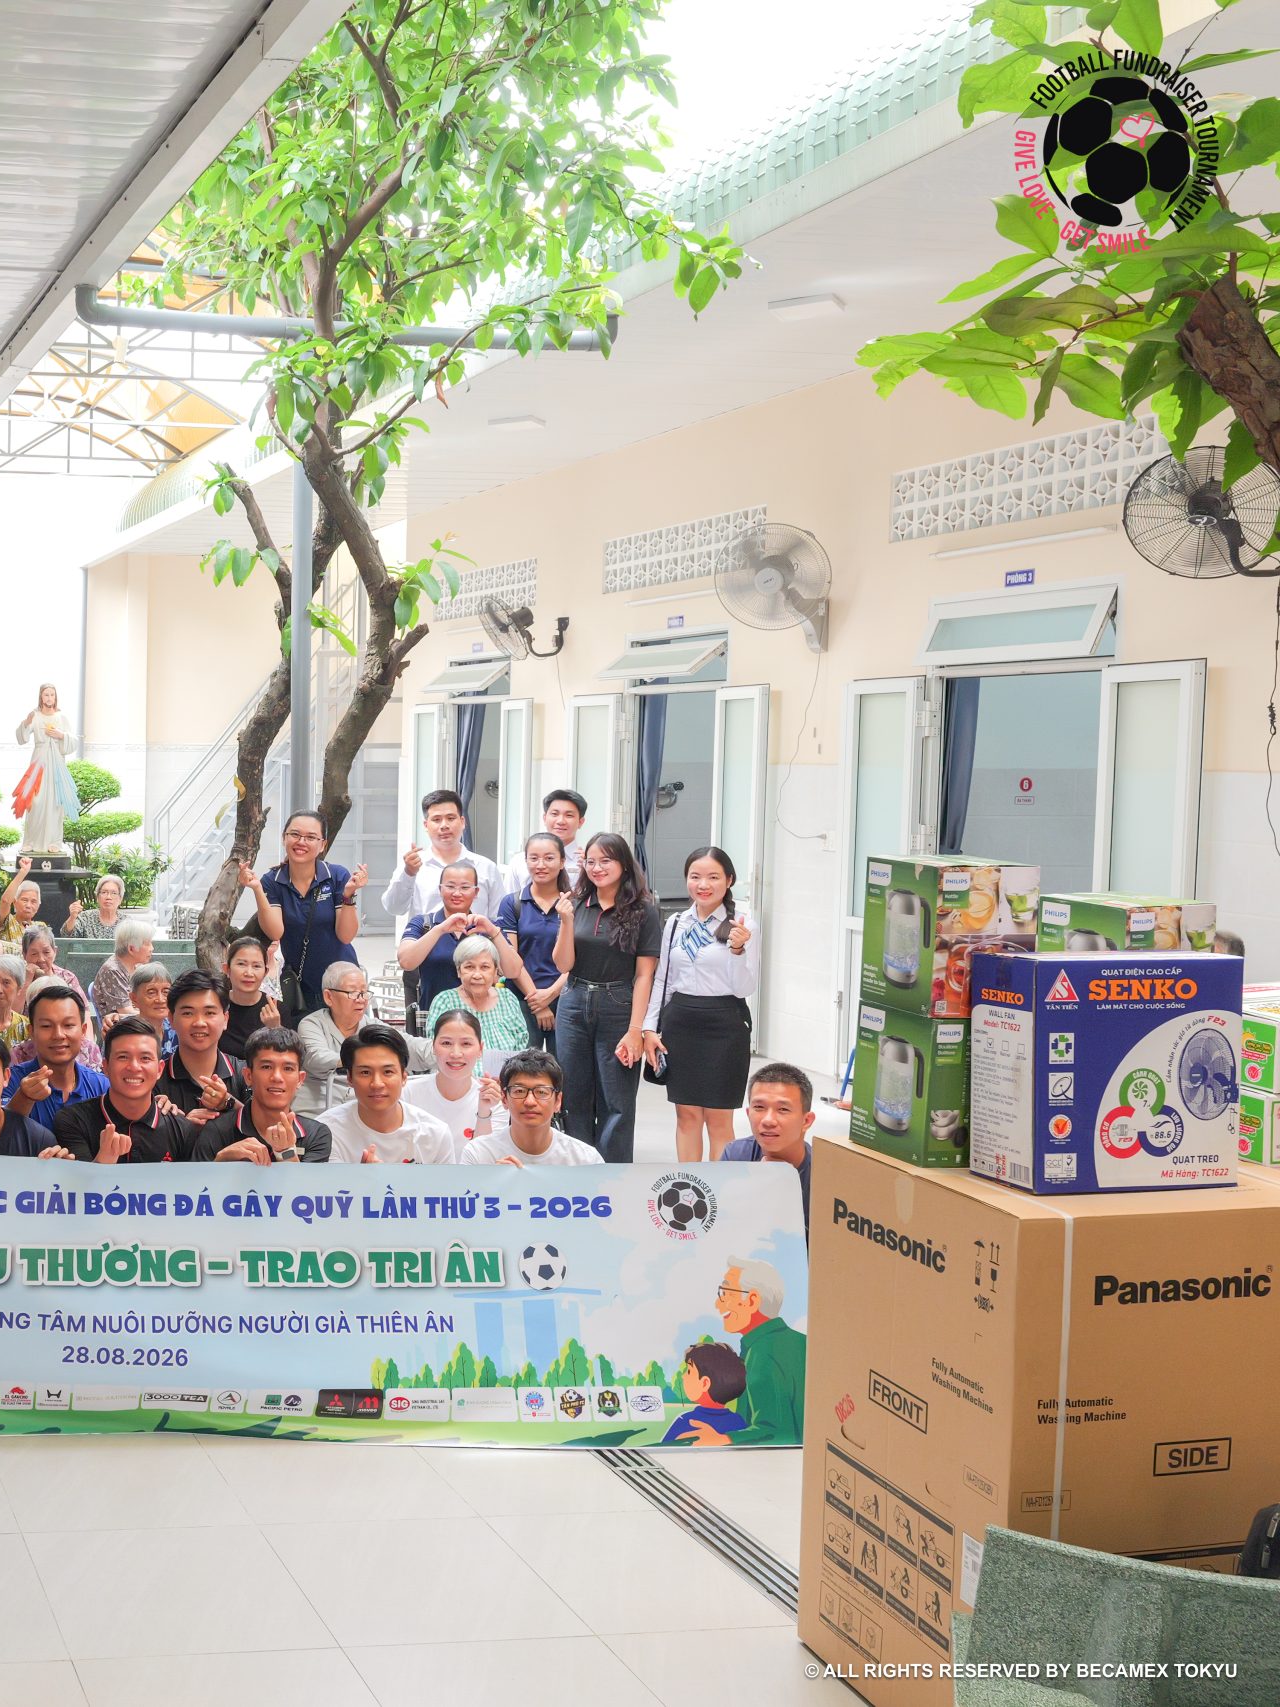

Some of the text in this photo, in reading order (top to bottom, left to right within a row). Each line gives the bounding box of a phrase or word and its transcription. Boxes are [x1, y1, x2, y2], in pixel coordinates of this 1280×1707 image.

[1028, 572, 1033, 582] 3
[871, 870, 890, 879] PHILIPS
[1044, 909, 1068, 919] PHILIPS
[1124, 968, 1144, 977] ĐIỆN
[1165, 966, 1182, 974] CẤP
[981, 988, 1024, 1005] SENKO
[1088, 978, 1198, 1001] SENKO
[1113, 1002, 1127, 1010] MÁT
[1145, 1002, 1165, 1010] CUỘC
[1166, 1001, 1185, 1009] SỐNG
[862, 1013, 883, 1025] PHILIPS
[988, 1009, 1016, 1020] WALL FAN
[1000, 1021, 1021, 1032] TC1622
[1132, 1070, 1148, 1079] CÁNH
[1172, 1155, 1219, 1165] QUẠT TREO
[1201, 1168, 1229, 1177] TC1622
[15, 1183, 77, 1215] GIẢI
[84, 1185, 167, 1217] BÓNG
[173, 1186, 214, 1217] ĐÁ
[222, 1189, 281, 1218] GÂY
[291, 1190, 351, 1224] QUỸ
[362, 1184, 418, 1219] LẦN
[424, 1190, 480, 1218] THỨ
[483, 1196, 501, 1218] 3
[529, 1196, 612, 1218] 2026
[651, 1172, 718, 1233] FOOTBALL FUNDRAISER TOURNAMENT
[648, 1199, 697, 1241] GIVE LOVE GET SMILE
[833, 1197, 946, 1273] Panasonic
[20, 1242, 198, 1284] THƯƠNG
[240, 1250, 357, 1284] TRAO
[368, 1250, 433, 1284] TRI
[443, 1242, 502, 1284] ÂN
[1094, 1268, 1272, 1305] Panasonic
[38, 1309, 86, 1333] TÂM
[92, 1309, 146, 1334] NUÔI
[152, 1309, 232, 1335] DƯỠNG
[239, 1312, 311, 1334] NGƯỜI
[315, 1312, 351, 1334] GIÀ
[360, 1311, 419, 1334] THIÊN
[424, 1311, 454, 1334] ÂN
[62, 1345, 188, 1367] 28.08.2026
[931, 1357, 984, 1394] Fully Automatic
[931, 1372, 993, 1414] Washing Machine
[391, 1399, 409, 1409] SIG
[873, 1379, 924, 1424] FRONT
[1064, 1396, 1113, 1408] Automatic
[1084, 1411, 1127, 1422] Machine
[1168, 1446, 1219, 1468] SIDE
